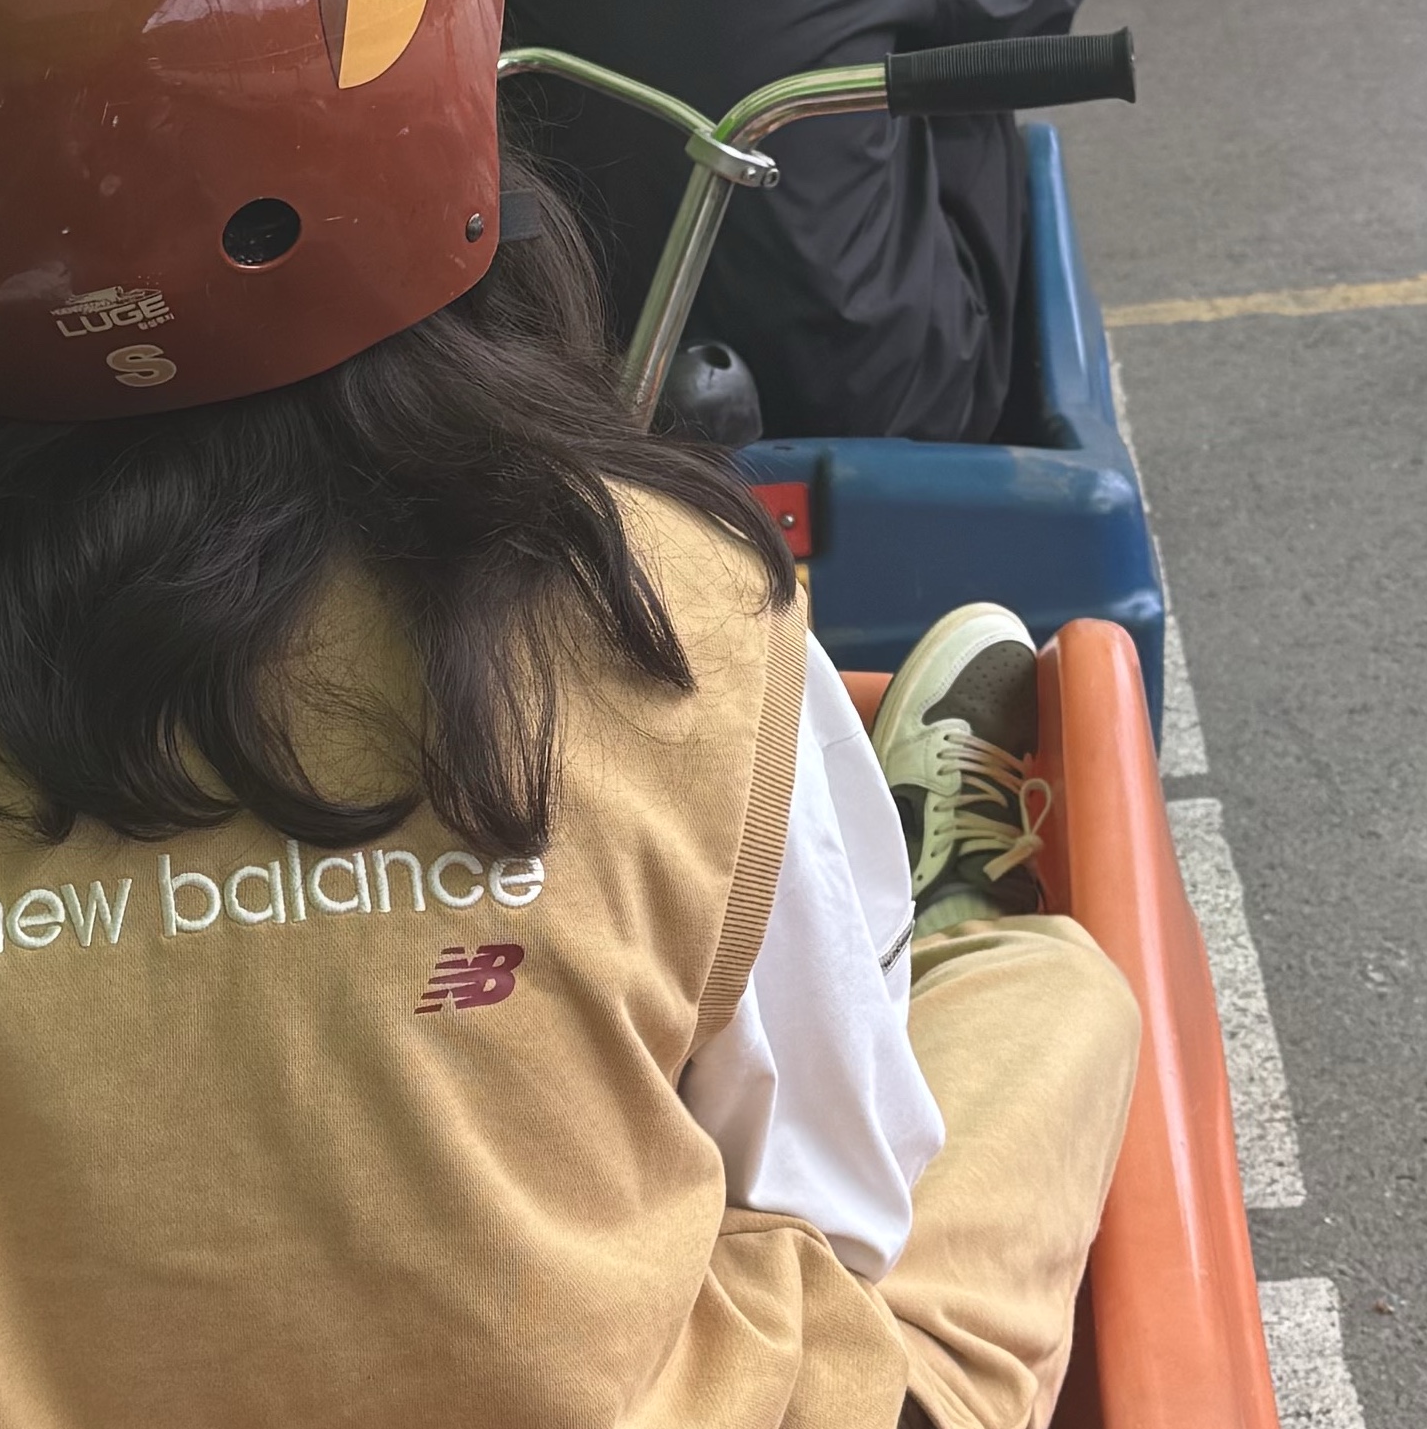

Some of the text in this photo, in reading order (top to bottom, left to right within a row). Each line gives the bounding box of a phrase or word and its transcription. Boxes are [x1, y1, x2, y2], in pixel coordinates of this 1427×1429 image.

[56, 294, 170, 337] LUGE
[106, 344, 177, 387] S
[158, 839, 546, 937] balance
